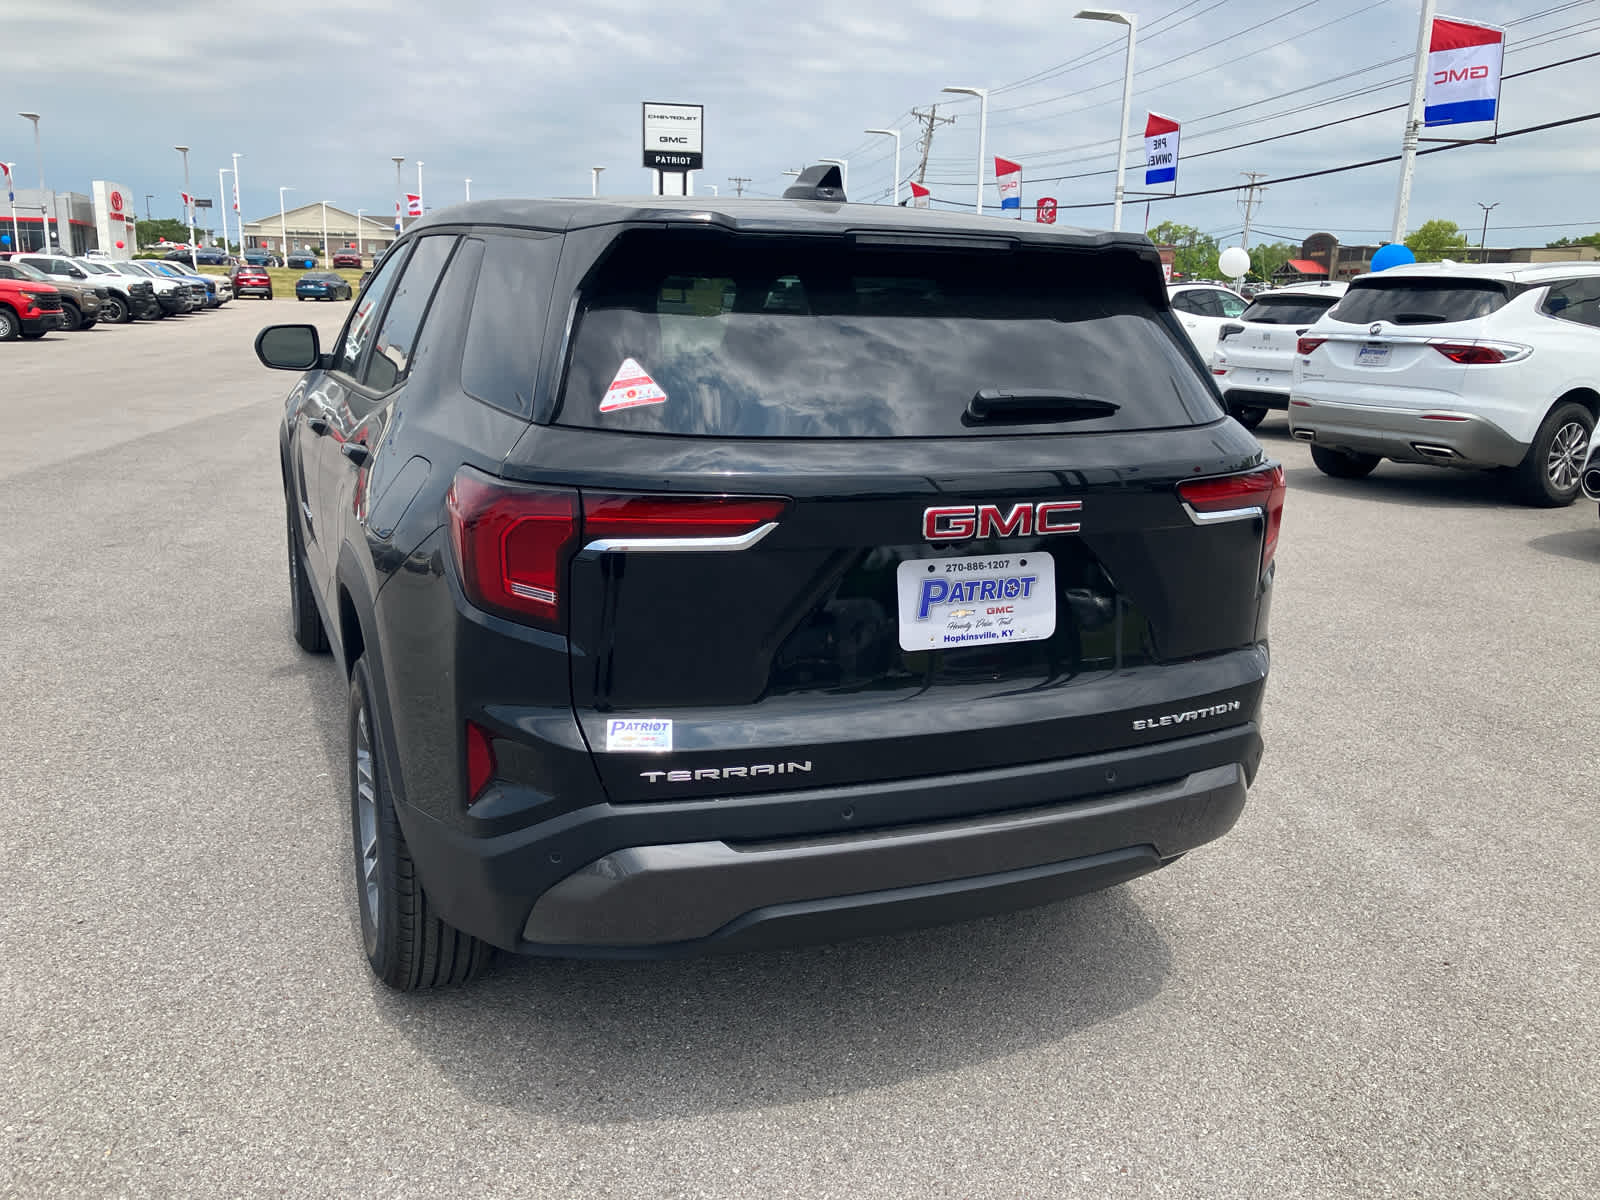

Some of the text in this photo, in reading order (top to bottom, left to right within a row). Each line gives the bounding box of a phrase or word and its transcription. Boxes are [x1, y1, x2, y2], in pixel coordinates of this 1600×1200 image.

[659, 136, 689, 144] GMC
[655, 155, 692, 165] PATRIOT
[922, 500, 1083, 540] GMC
[945, 560, 1010, 573] 270-886-1207
[916, 575, 1037, 622] PATRIOT
[986, 605, 1014, 615] GMC
[943, 631, 999, 644] Hopkinsville,
[1001, 629, 1015, 638] KY
[1132, 700, 1241, 730] ELEVATION
[610, 721, 670, 737] PATRIOT
[640, 760, 812, 783] TERRAIN
